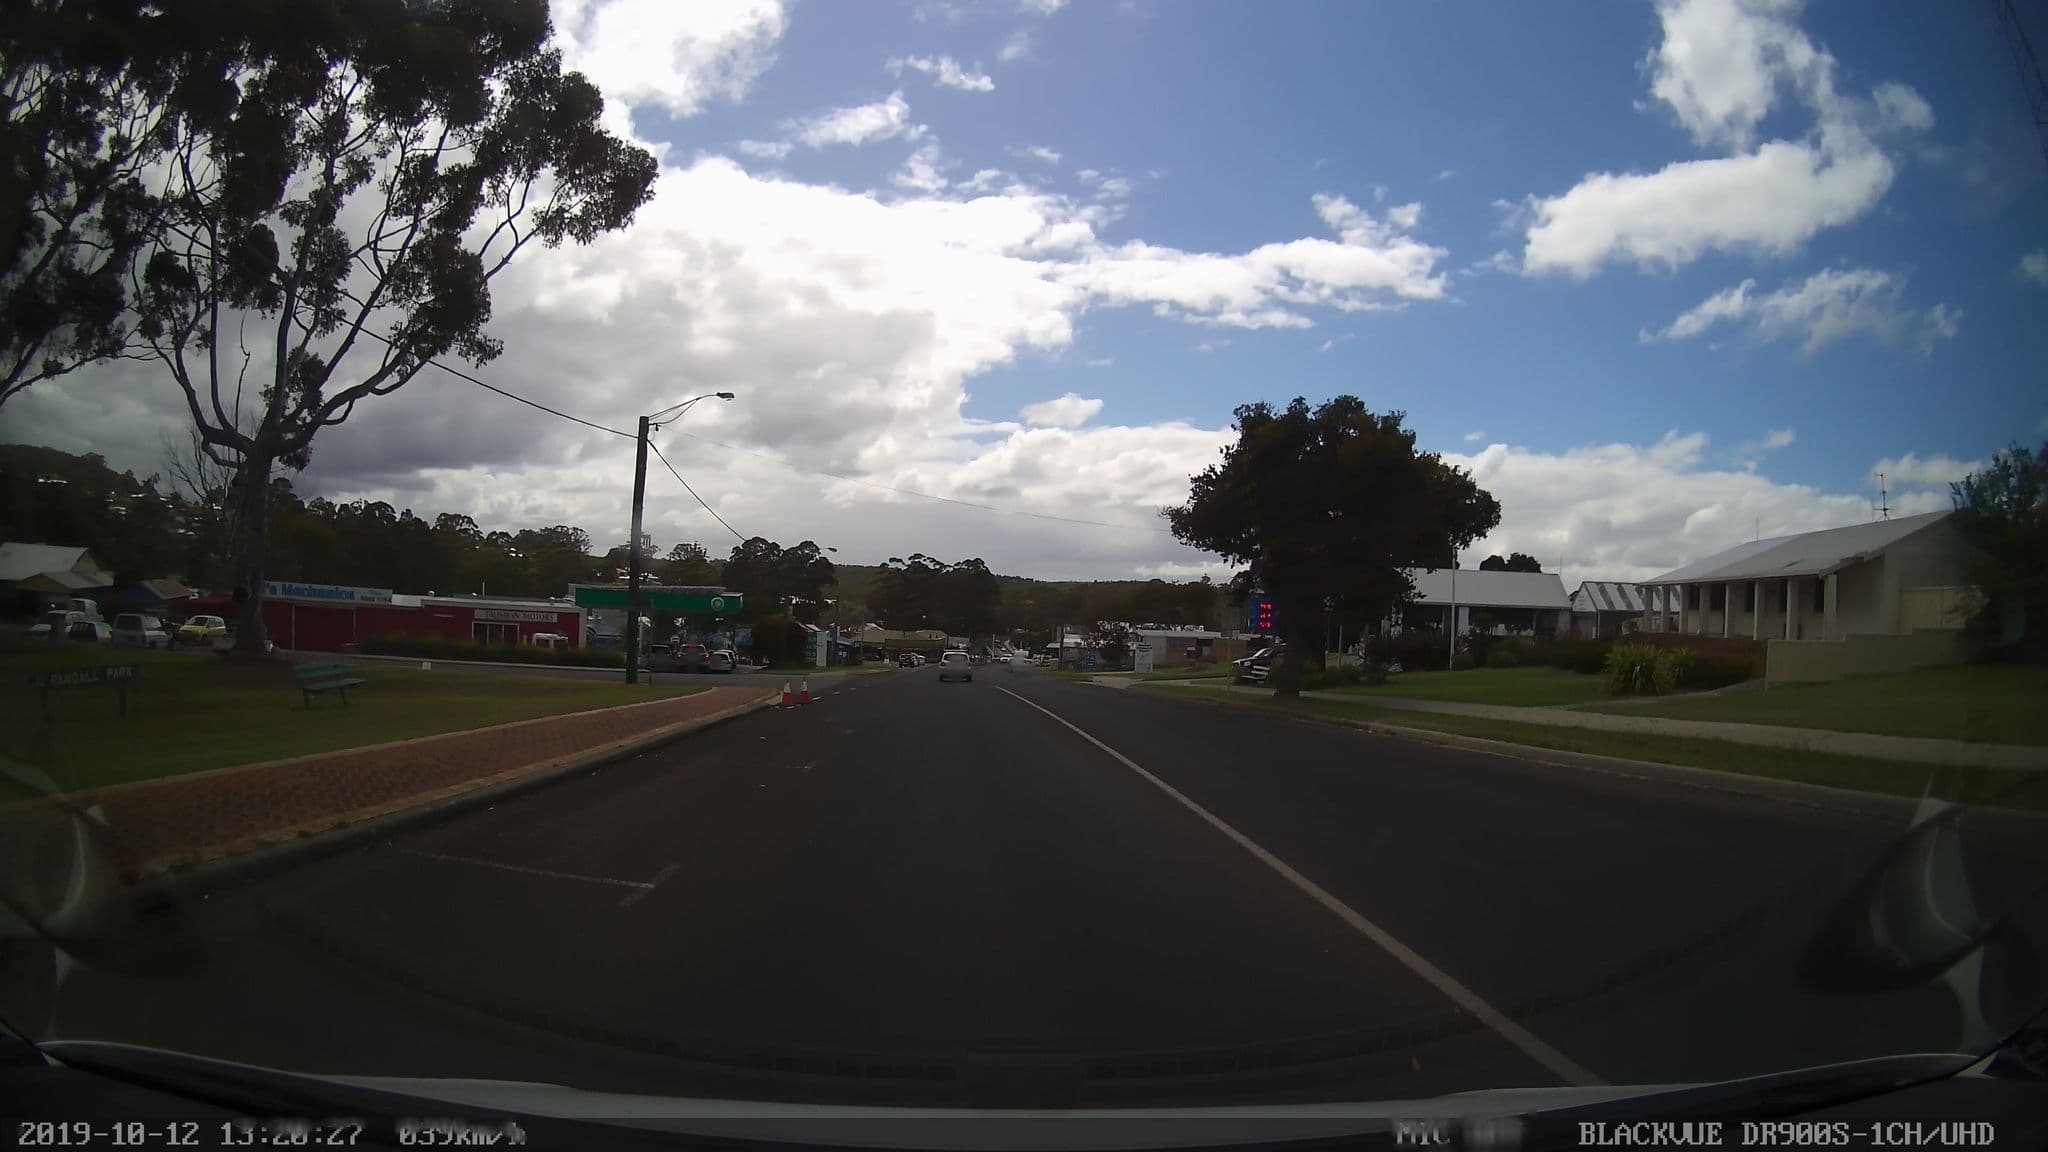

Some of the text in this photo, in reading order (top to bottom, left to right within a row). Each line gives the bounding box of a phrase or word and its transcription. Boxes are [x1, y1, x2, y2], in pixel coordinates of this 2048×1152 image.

[281, 584, 355, 601] Mechanics
[50, 666, 136, 685] RANDALL PARK
